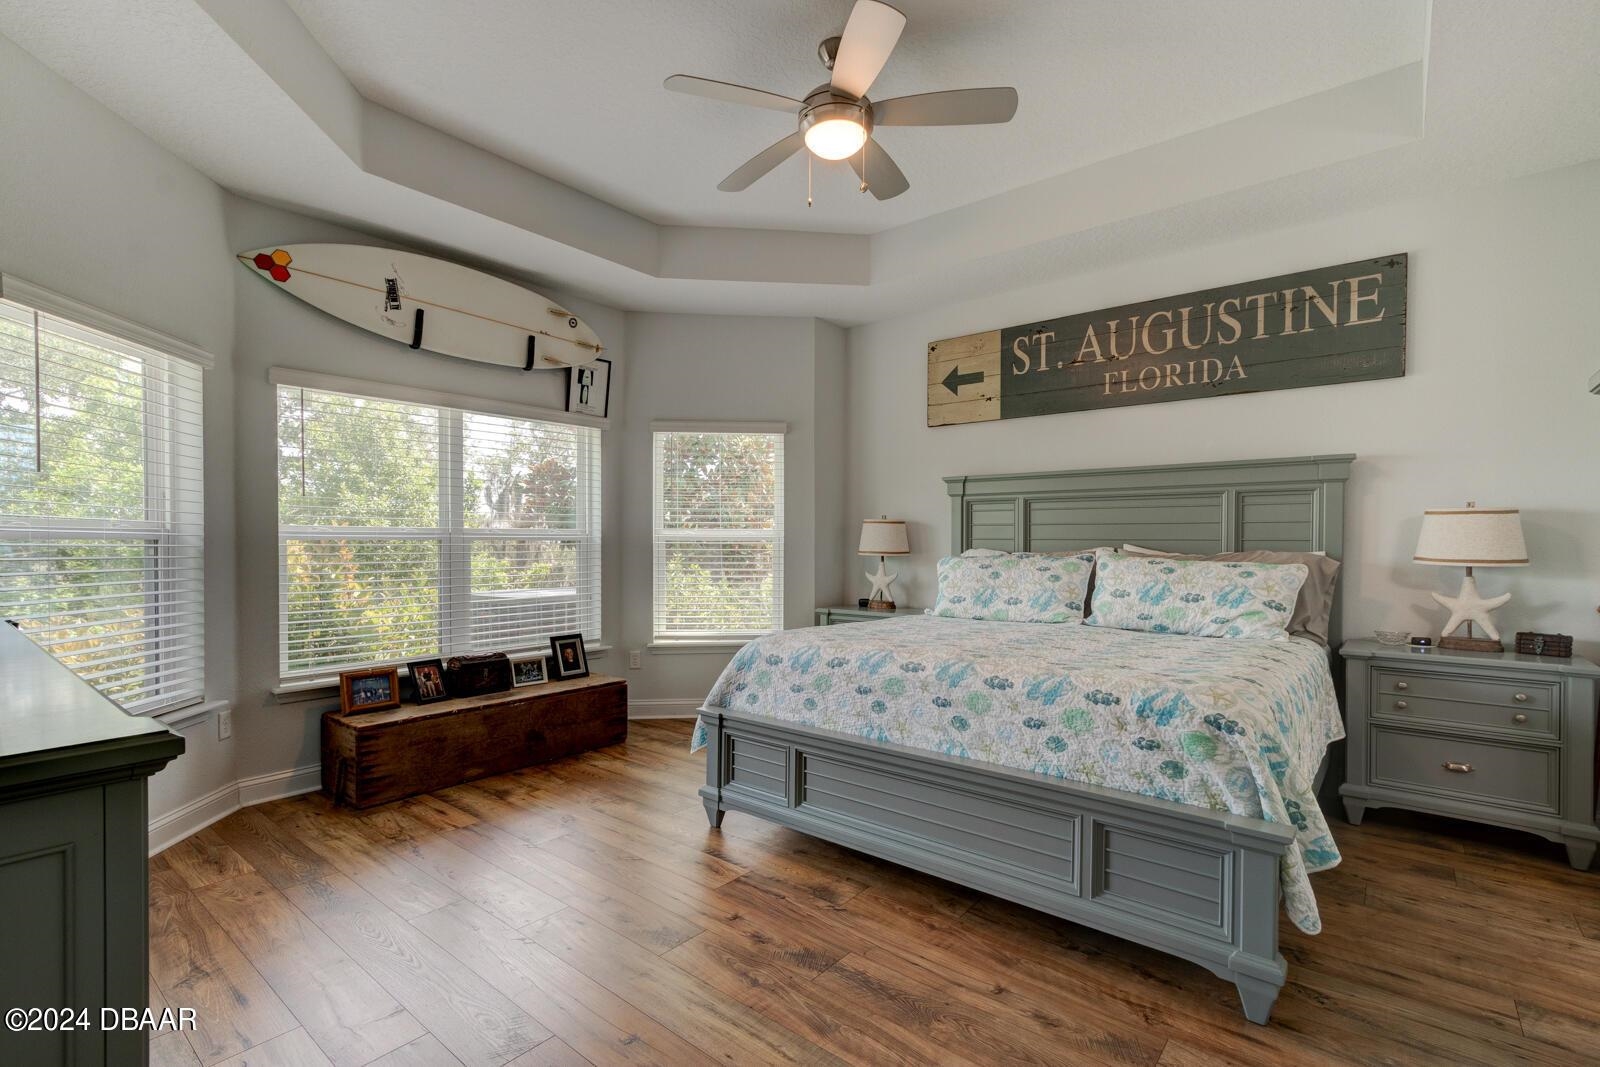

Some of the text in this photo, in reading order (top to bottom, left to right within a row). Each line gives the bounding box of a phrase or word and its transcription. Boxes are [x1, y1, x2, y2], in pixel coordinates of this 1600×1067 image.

[1012, 273, 1385, 376] ST. AUGUSTINE
[1103, 354, 1248, 395] FLORIDA
